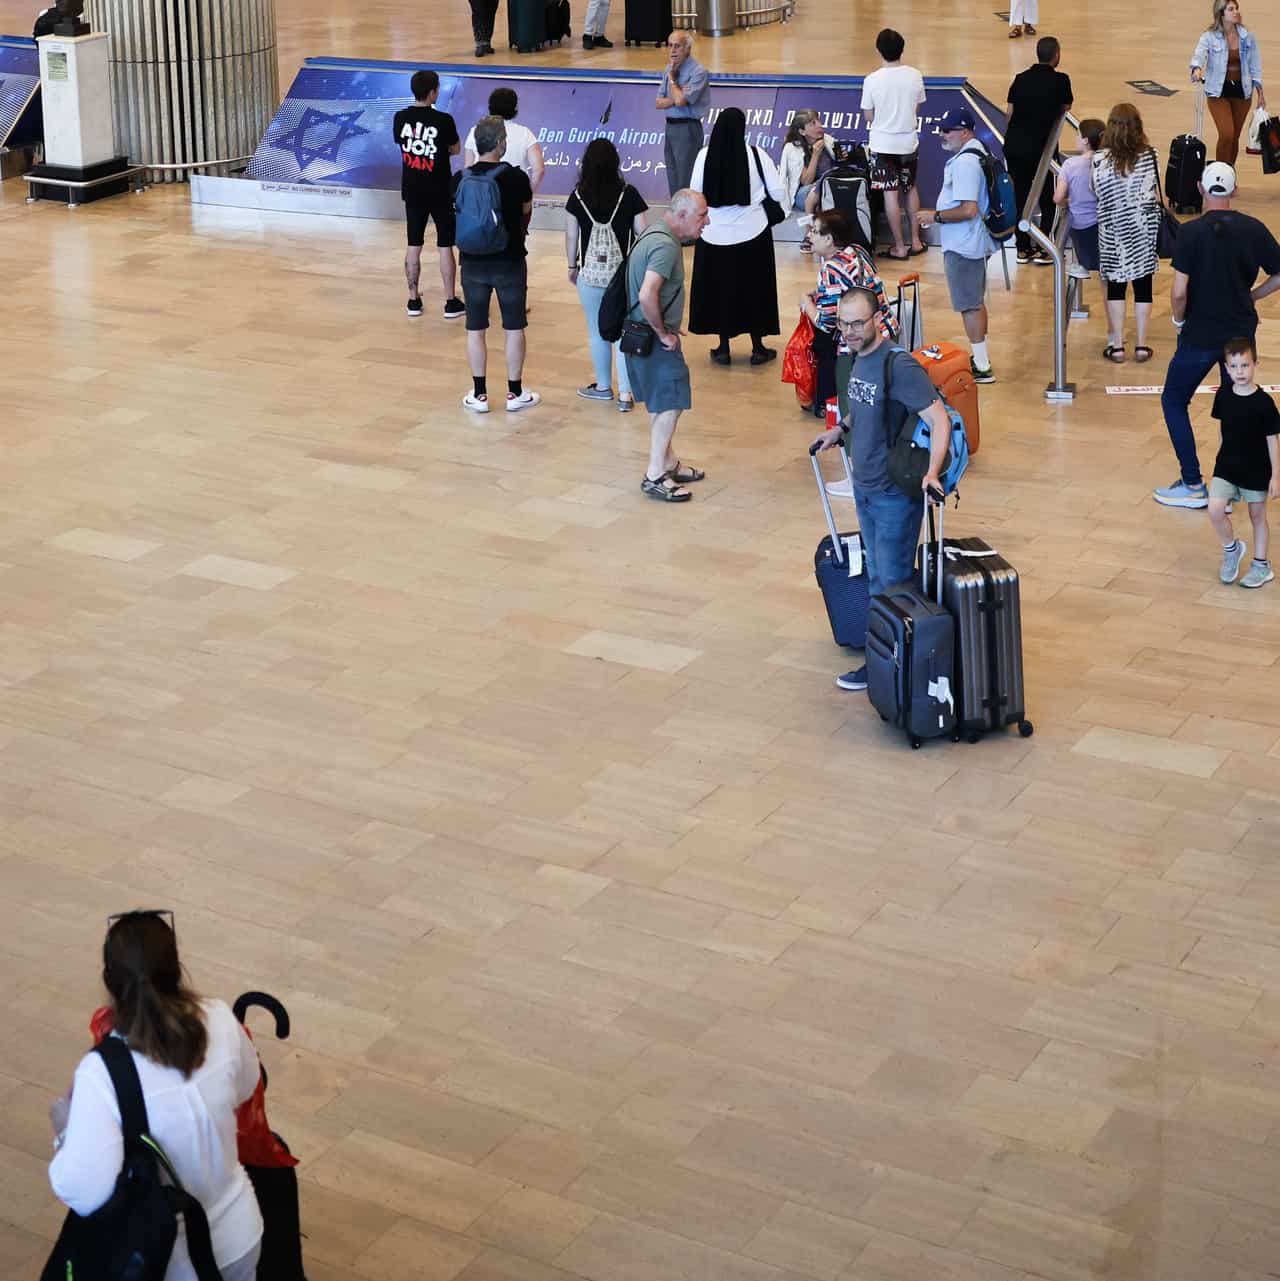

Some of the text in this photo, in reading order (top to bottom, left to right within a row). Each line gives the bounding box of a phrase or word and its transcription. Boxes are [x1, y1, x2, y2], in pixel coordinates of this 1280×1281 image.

[400, 121, 439, 143] AIR
[538, 127, 778, 150] Ben Gurion Airpor for
[401, 138, 438, 160] JOR
[402, 152, 434, 173] DAN
